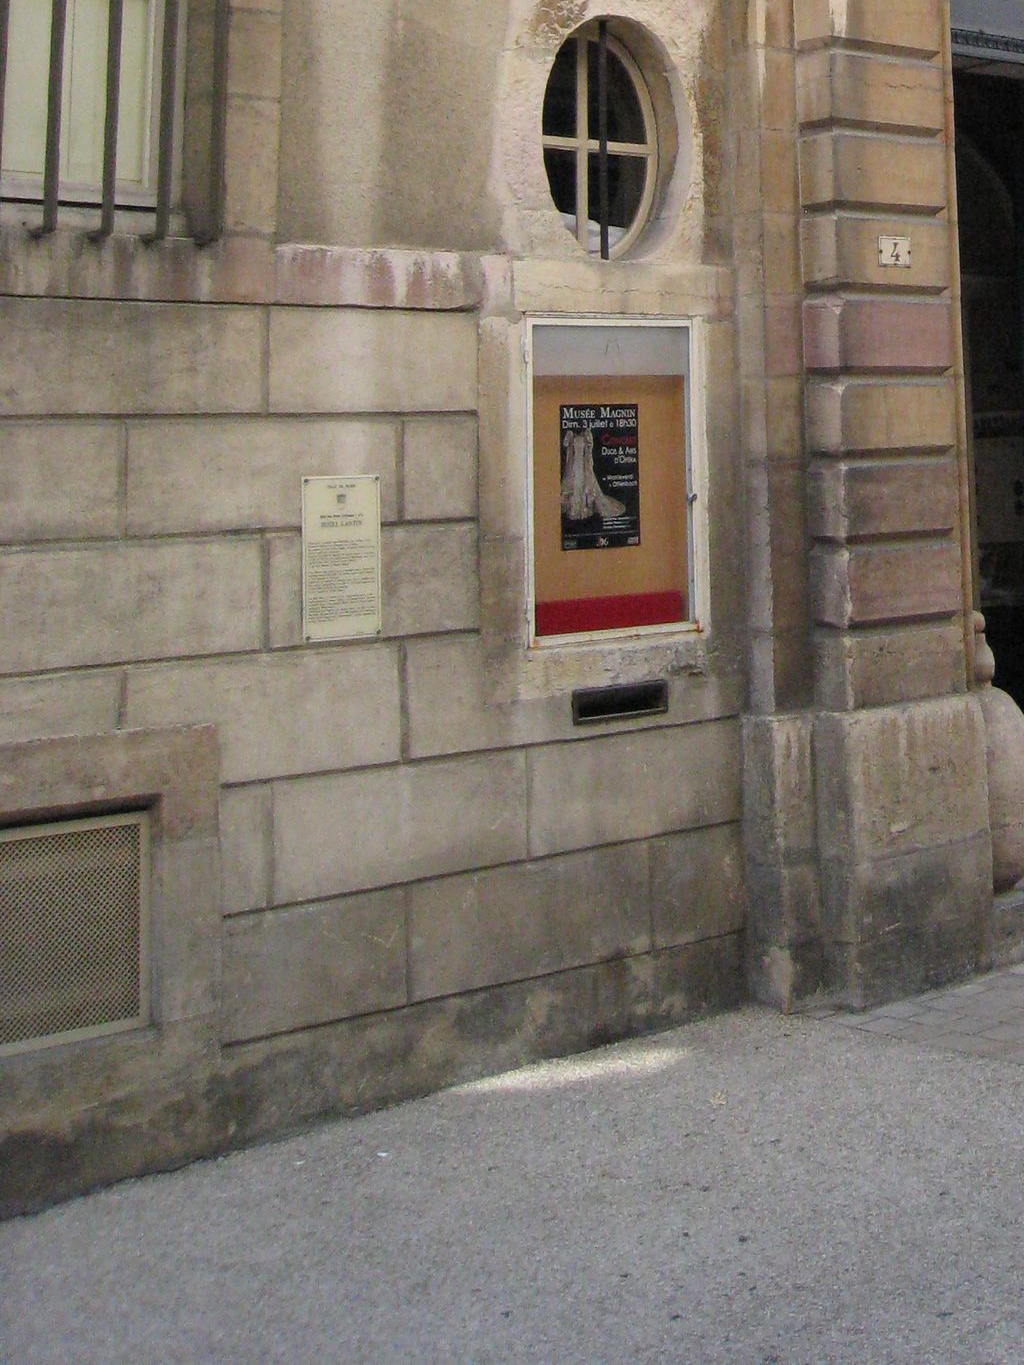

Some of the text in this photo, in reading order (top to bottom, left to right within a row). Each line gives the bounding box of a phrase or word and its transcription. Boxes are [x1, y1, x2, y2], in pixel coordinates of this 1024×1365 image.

[890, 241, 901, 262] 4
[600, 406, 636, 418] MAGNIN
[616, 419, 637, 428] 18h30
